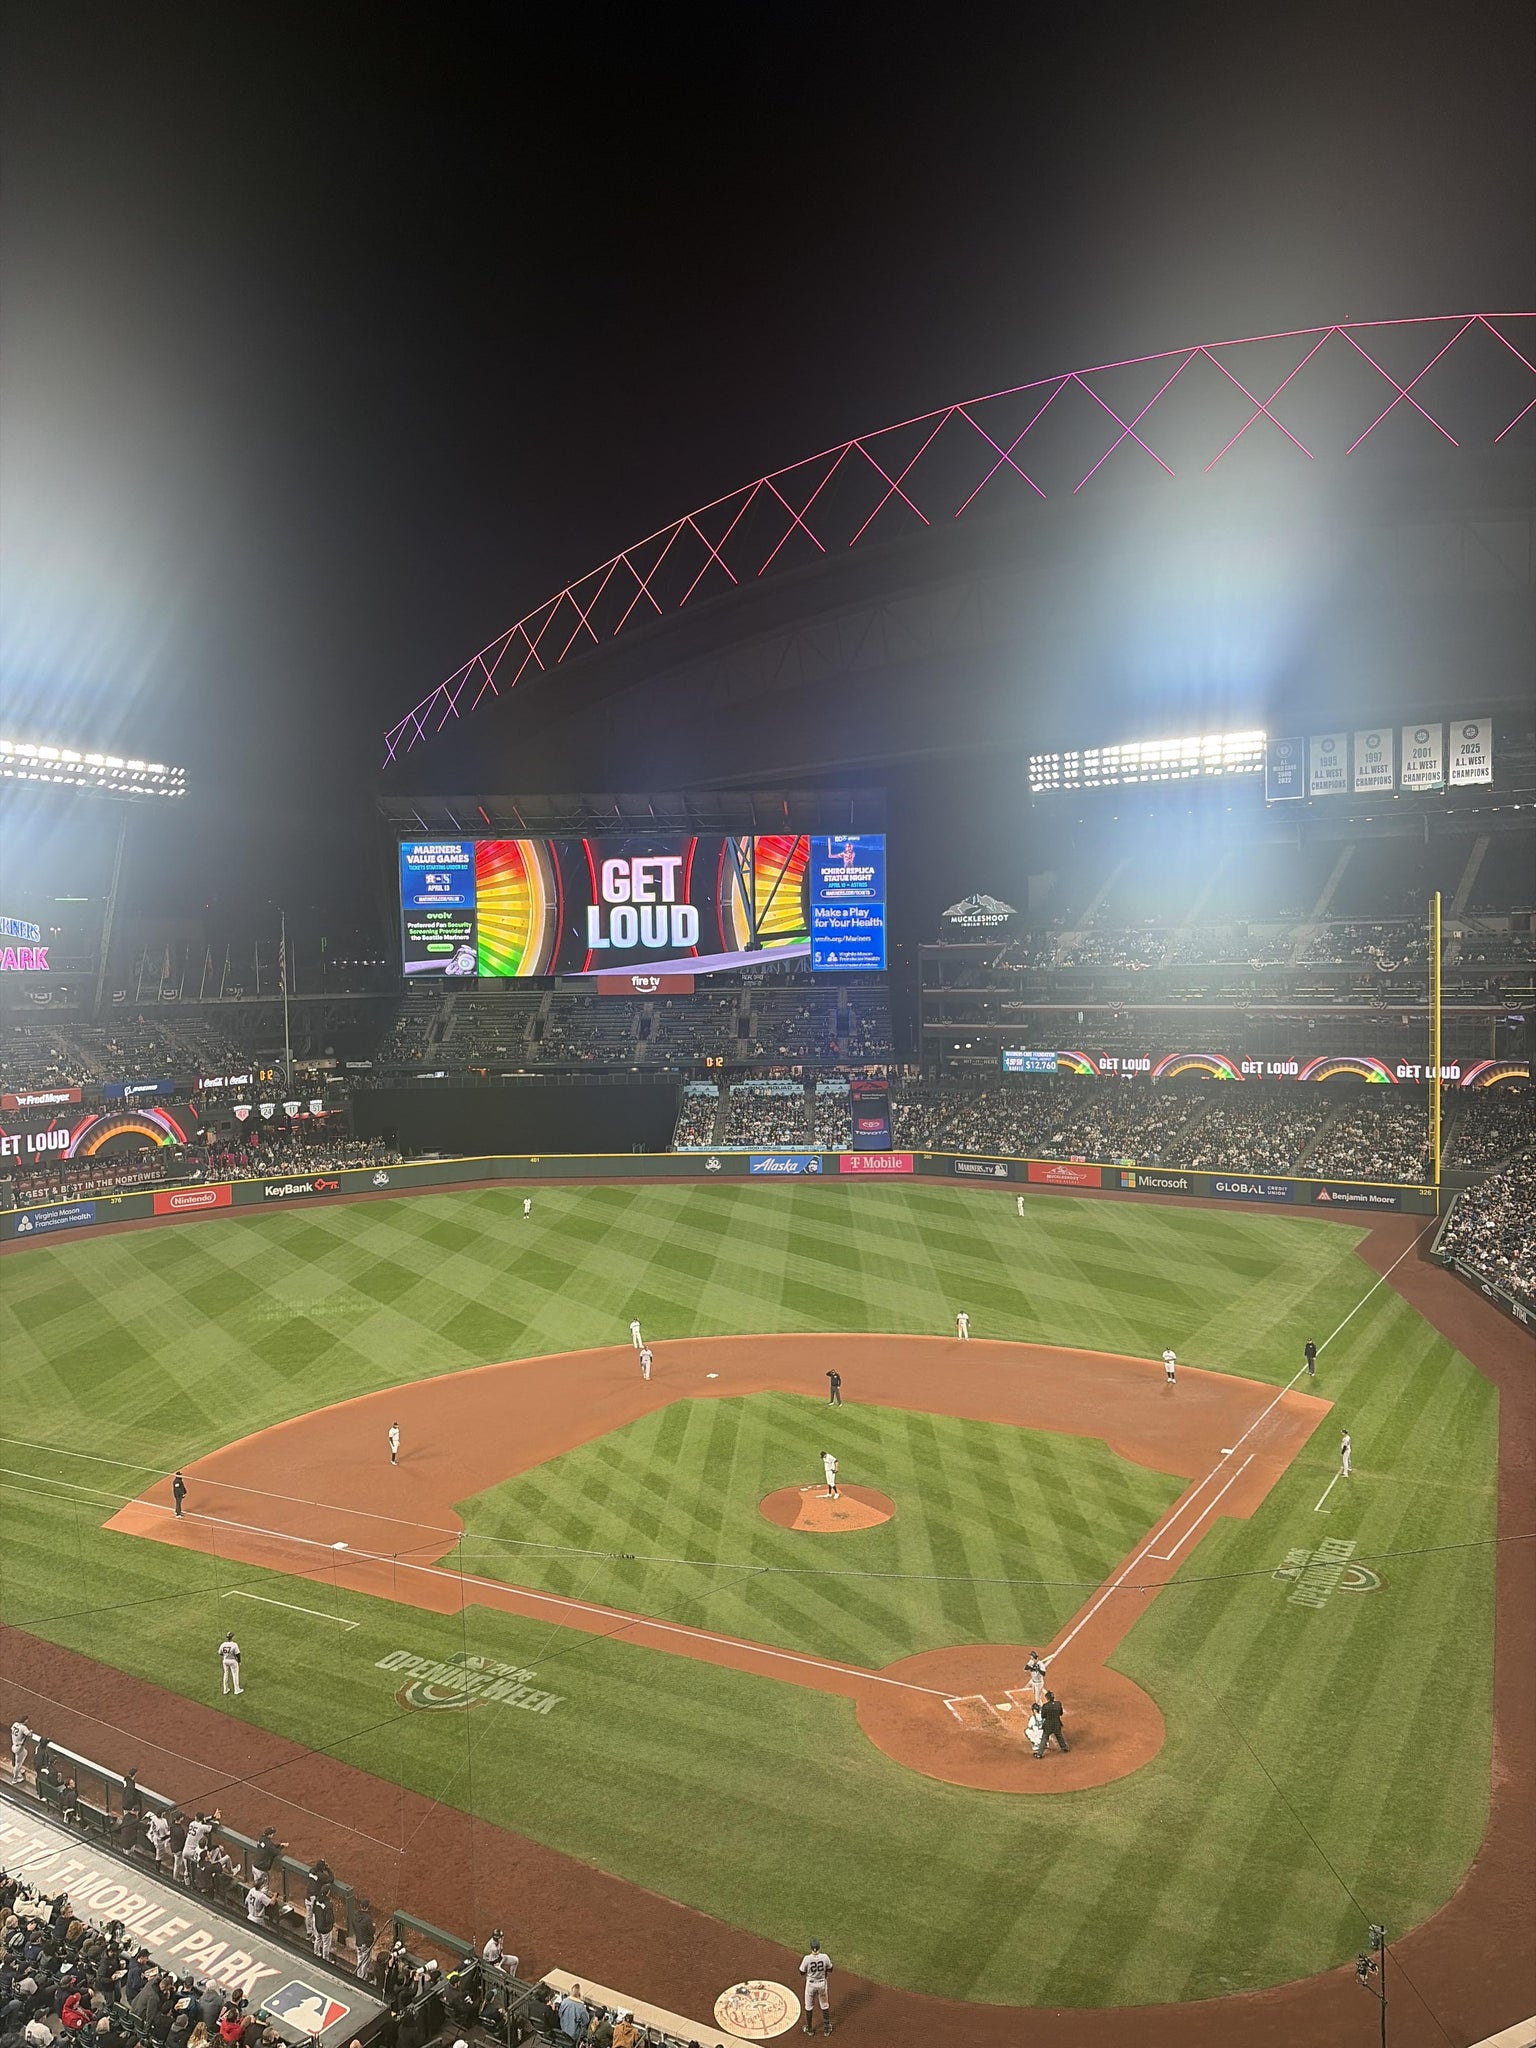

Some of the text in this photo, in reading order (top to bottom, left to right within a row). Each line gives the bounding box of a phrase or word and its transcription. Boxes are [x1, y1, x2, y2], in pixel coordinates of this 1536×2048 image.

[1413, 747, 1431, 758] 2001
[1460, 743, 1481, 754] 2025
[1320, 756, 1337, 767] 1995
[1365, 751, 1382, 763] 1997
[1468, 756, 1486, 765] WEST
[1371, 765, 1388, 774] WEST
[1420, 760, 1437, 769] WEST
[1326, 768, 1343, 777] WEST
[1403, 772, 1440, 782] CHAMPIONS
[1452, 767, 1489, 778] CHAMPIONS
[1312, 779, 1346, 790] CHAMPIONS
[1356, 775, 1391, 786] CHAMPIONS
[414, 845, 462, 854] MARINERS
[407, 855, 469, 863] VALUE GAMES
[602, 856, 682, 903] GET
[815, 908, 841, 917] Make
[850, 907, 869, 918] Play
[815, 917, 883, 927] for Your Health
[951, 915, 1009, 923] MUCKLESHOOT
[0, 916, 40, 943] RINERS
[448, 922, 472, 930] Security
[588, 905, 699, 949] LOUD
[0, 946, 50, 970] ARK
[632, 976, 660, 986] fire tv
[1100, 1058, 1150, 1070] GET LOUD
[1241, 1062, 1298, 1074] GET LOUD
[1397, 1065, 1421, 1078] GET
[263, 1108, 272, 1116] 24
[27, 1129, 70, 1152] LOUD
[753, 1158, 799, 1172] Alaska
[863, 1157, 902, 1169] Mobile
[85, 1181, 94, 1189] IN
[97, 1178, 113, 1187] THE
[1138, 1176, 1188, 1189] Microsoft
[1216, 1182, 1265, 1194] GLOBAL
[265, 1183, 313, 1196] KeyBank
[174, 1194, 212, 1205] Nintendo
[1332, 1192, 1395, 1204] Benjamin Moore
[34, 1207, 80, 1222] Virginia Mason
[35, 1213, 91, 1228] Franciscan Health
[1512, 1304, 1528, 1324] STIHL
[223, 1646, 231, 1654] 67
[488, 1663, 537, 1682] 2026
[375, 1650, 567, 1714] OPENING WEEK
[12, 1726, 19, 1736] 72
[188, 1825, 198, 1836] 25
[8, 1837, 61, 1871] TO
[46, 1859, 194, 1946] T-MOBILE
[166, 1928, 282, 1998] PARK
[810, 1960, 824, 1973] 22
